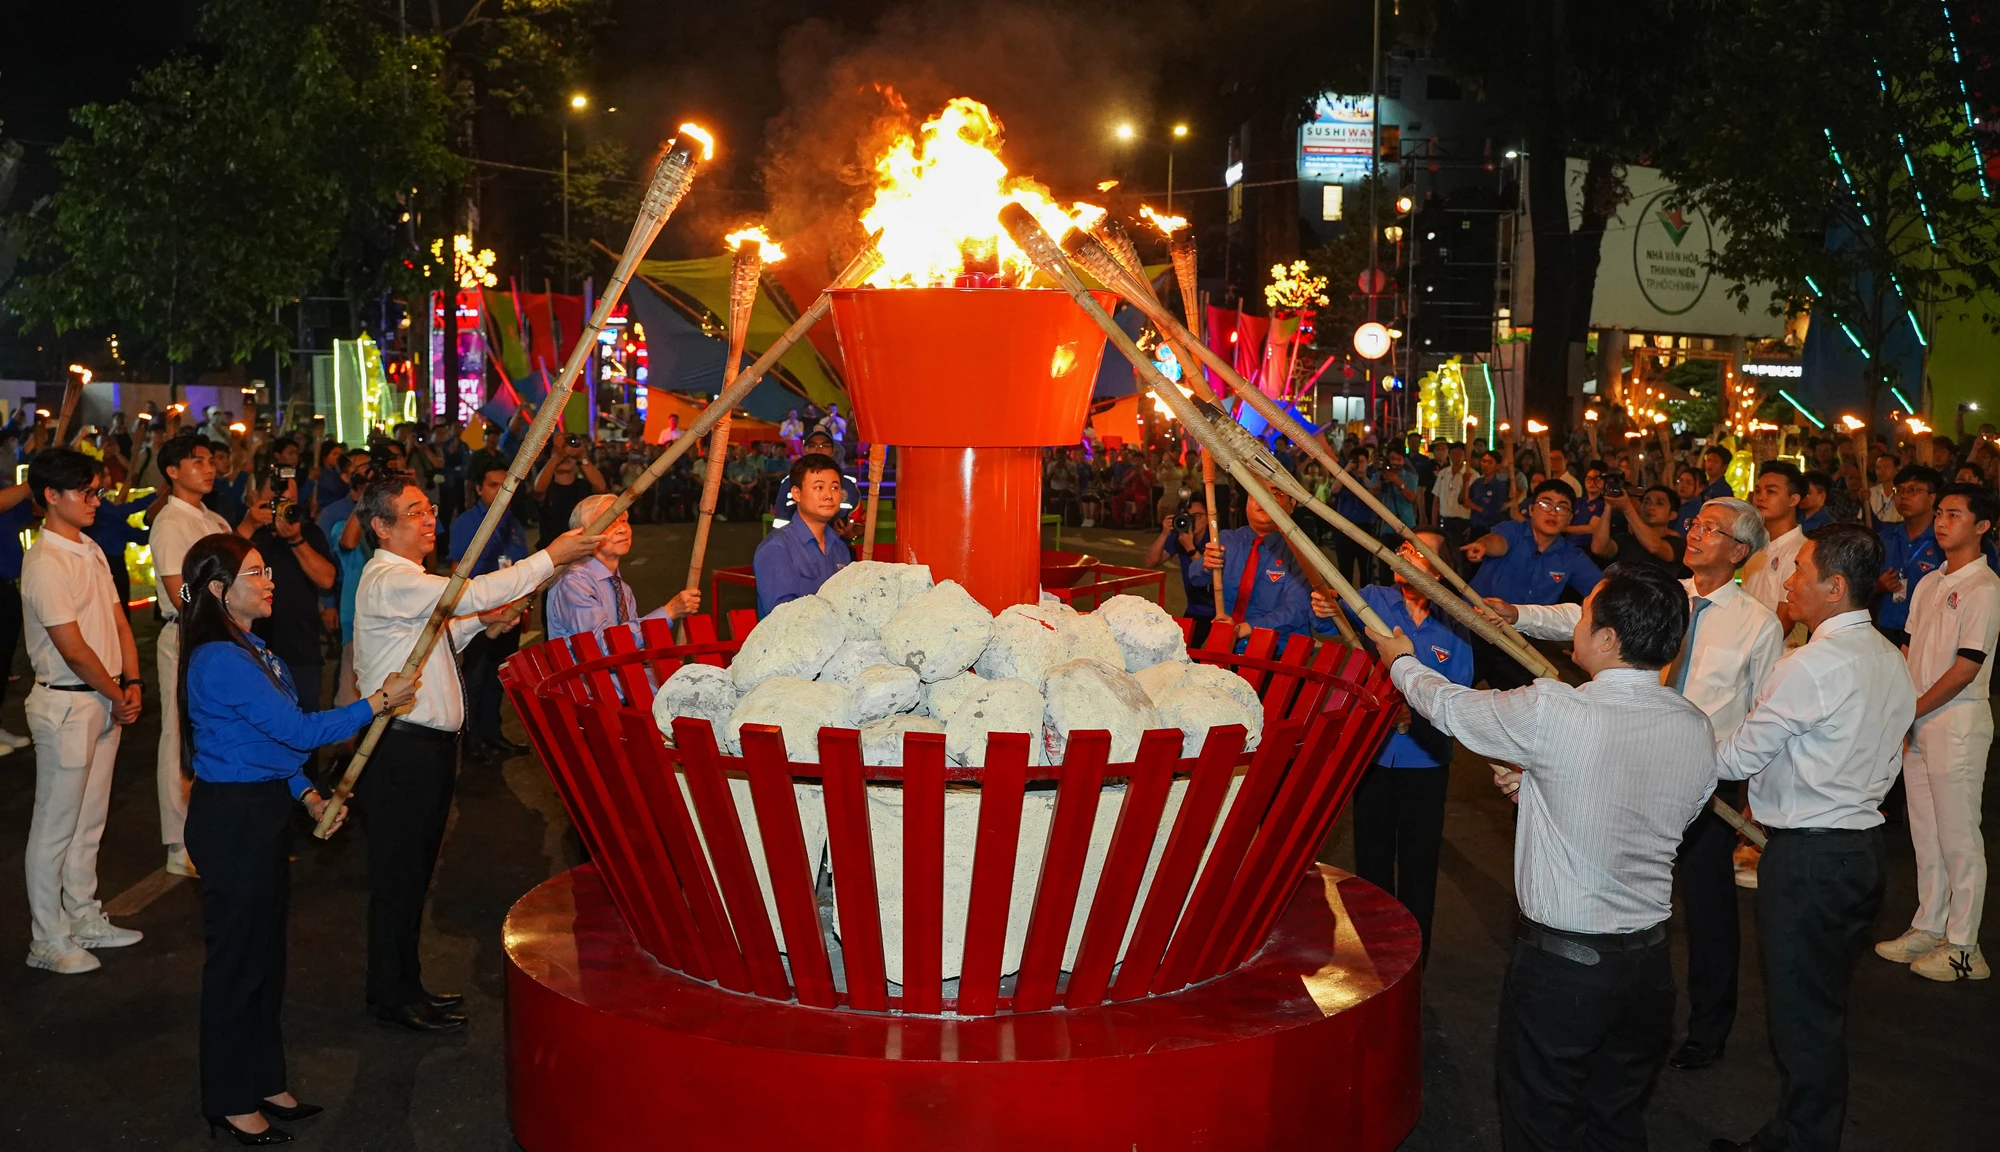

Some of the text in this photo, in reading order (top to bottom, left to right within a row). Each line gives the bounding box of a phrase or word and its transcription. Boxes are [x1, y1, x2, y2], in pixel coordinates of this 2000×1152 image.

[1646, 249, 1663, 260] NHÀ
[1650, 265, 1696, 277] THANH NIÊN
[435, 379, 479, 393] HPY
